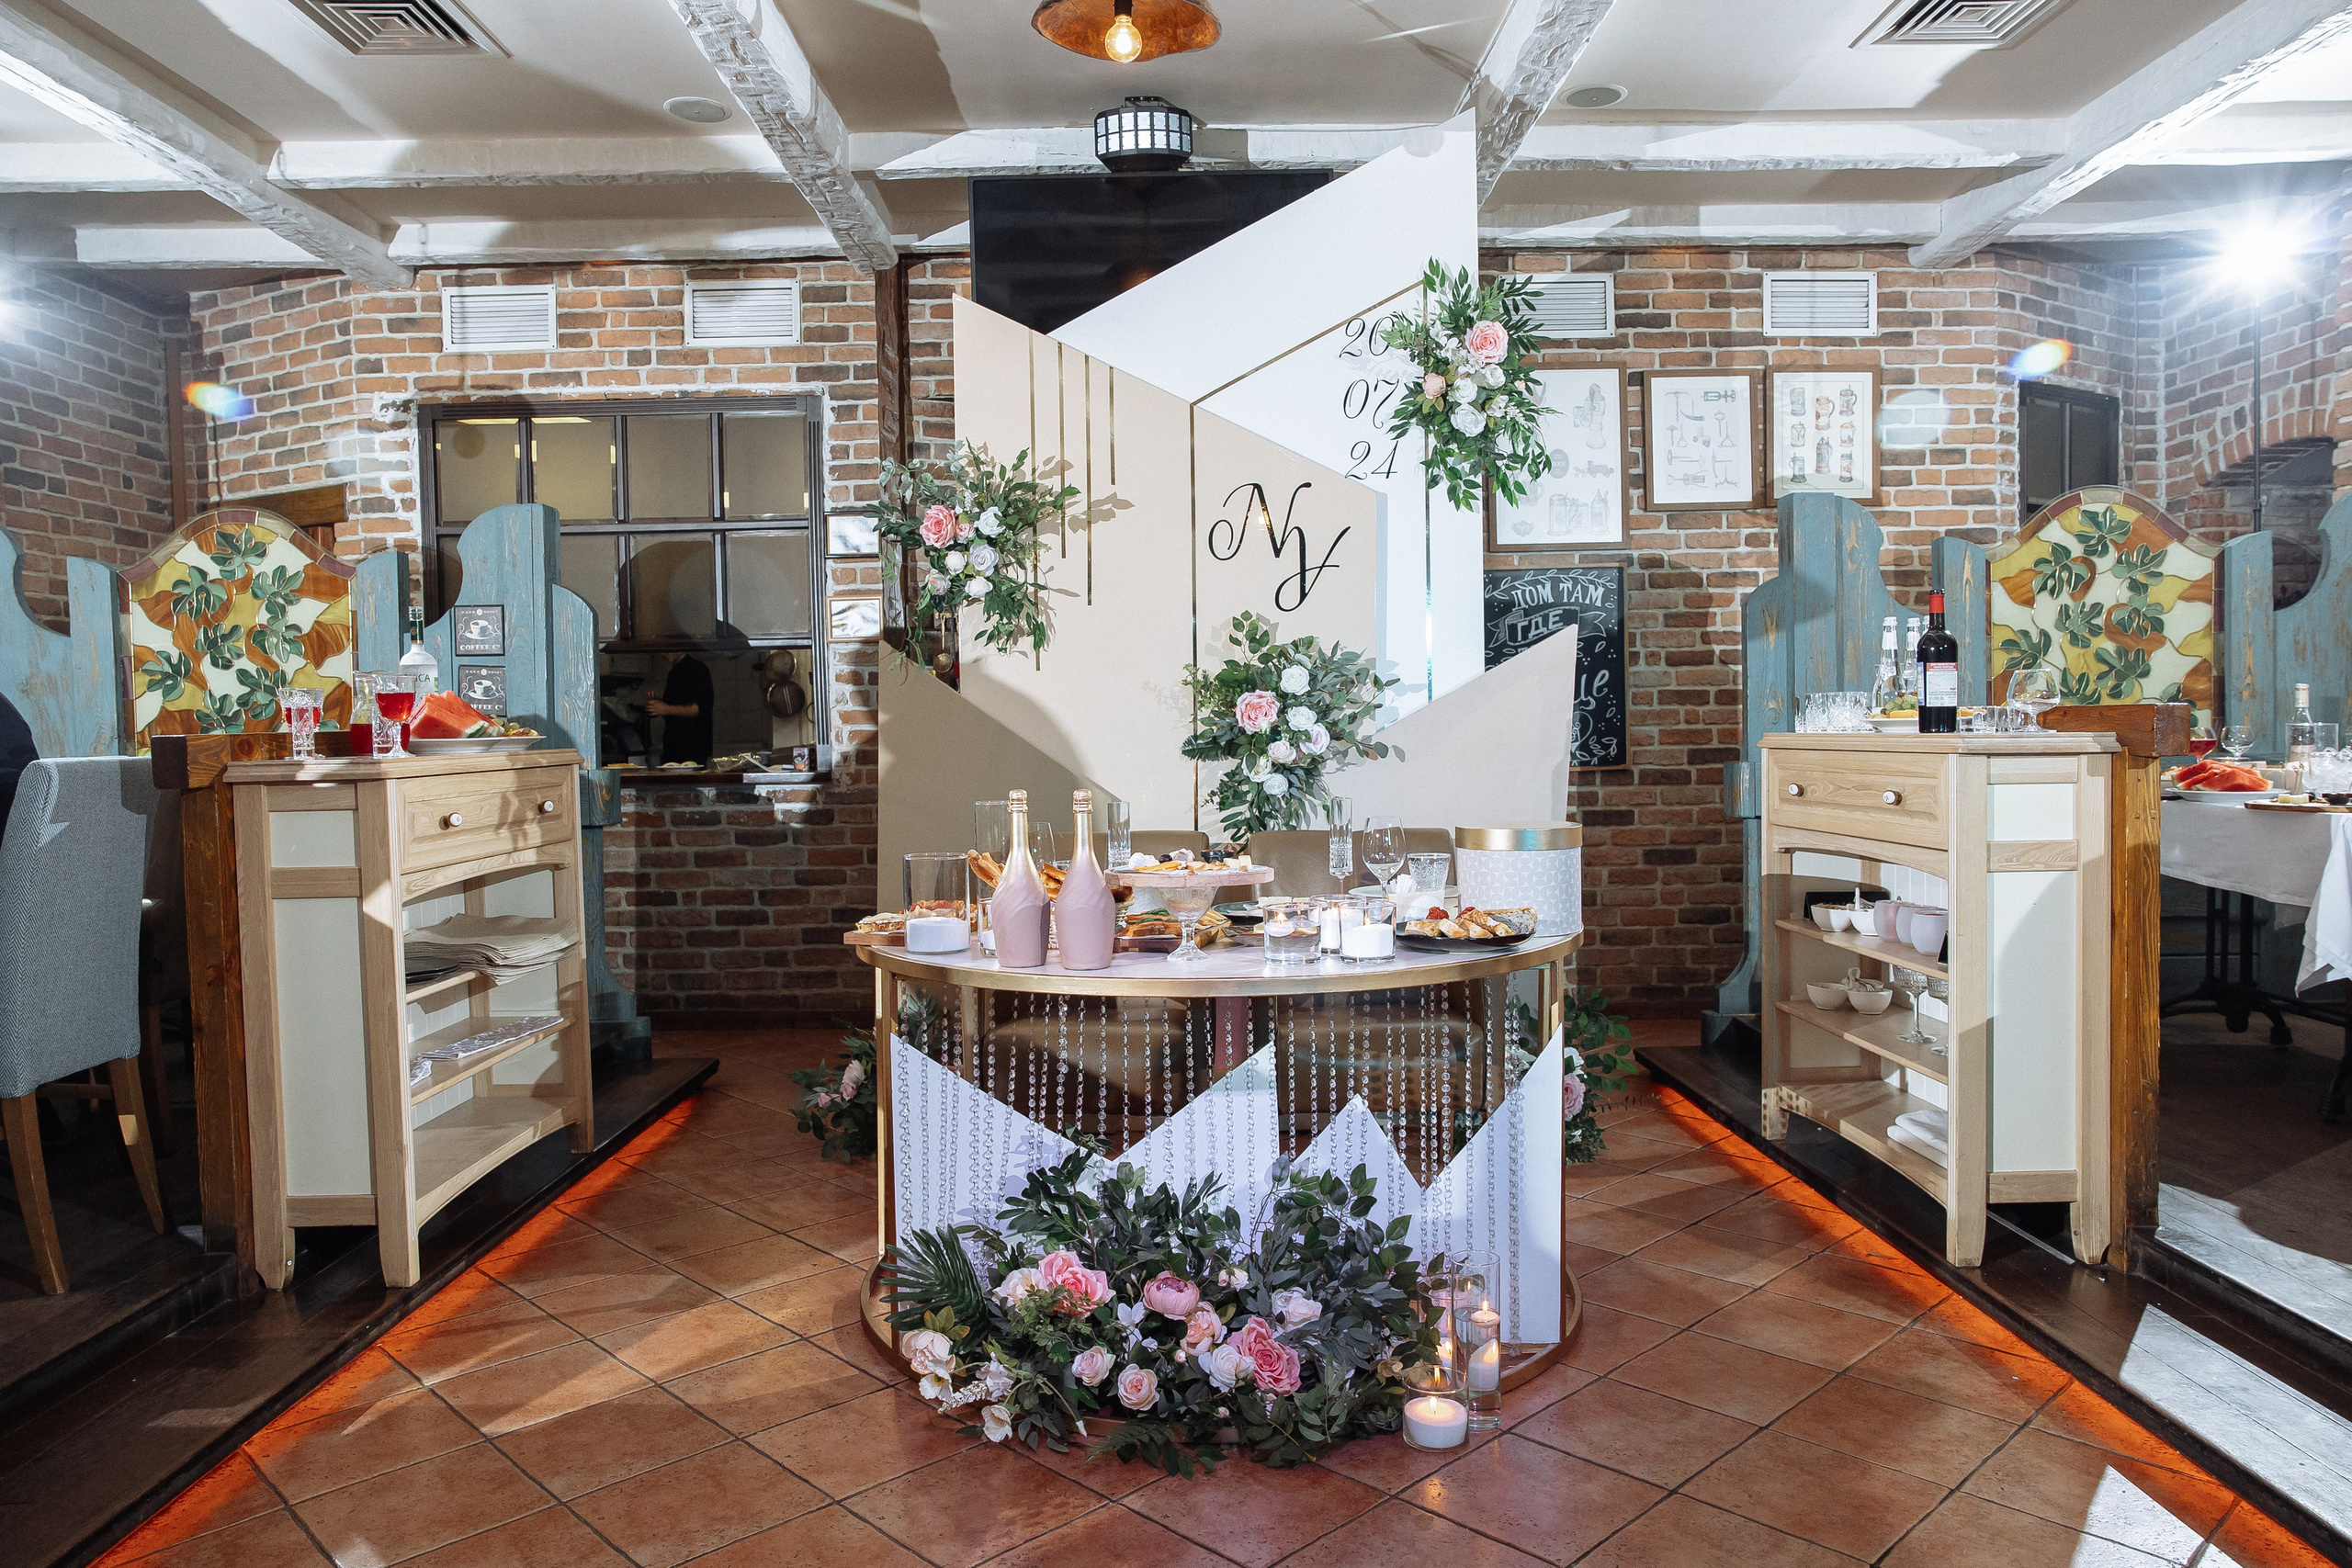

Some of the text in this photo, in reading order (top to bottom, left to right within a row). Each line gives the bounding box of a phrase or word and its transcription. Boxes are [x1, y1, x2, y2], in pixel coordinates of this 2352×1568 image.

[1339, 316, 1395, 357] 20
[1343, 378, 1399, 429] 07
[1344, 440, 1399, 479] 24
[1510, 582, 1606, 612] ДОМ ТАМ
[1517, 610, 1564, 642] ГДЕ
